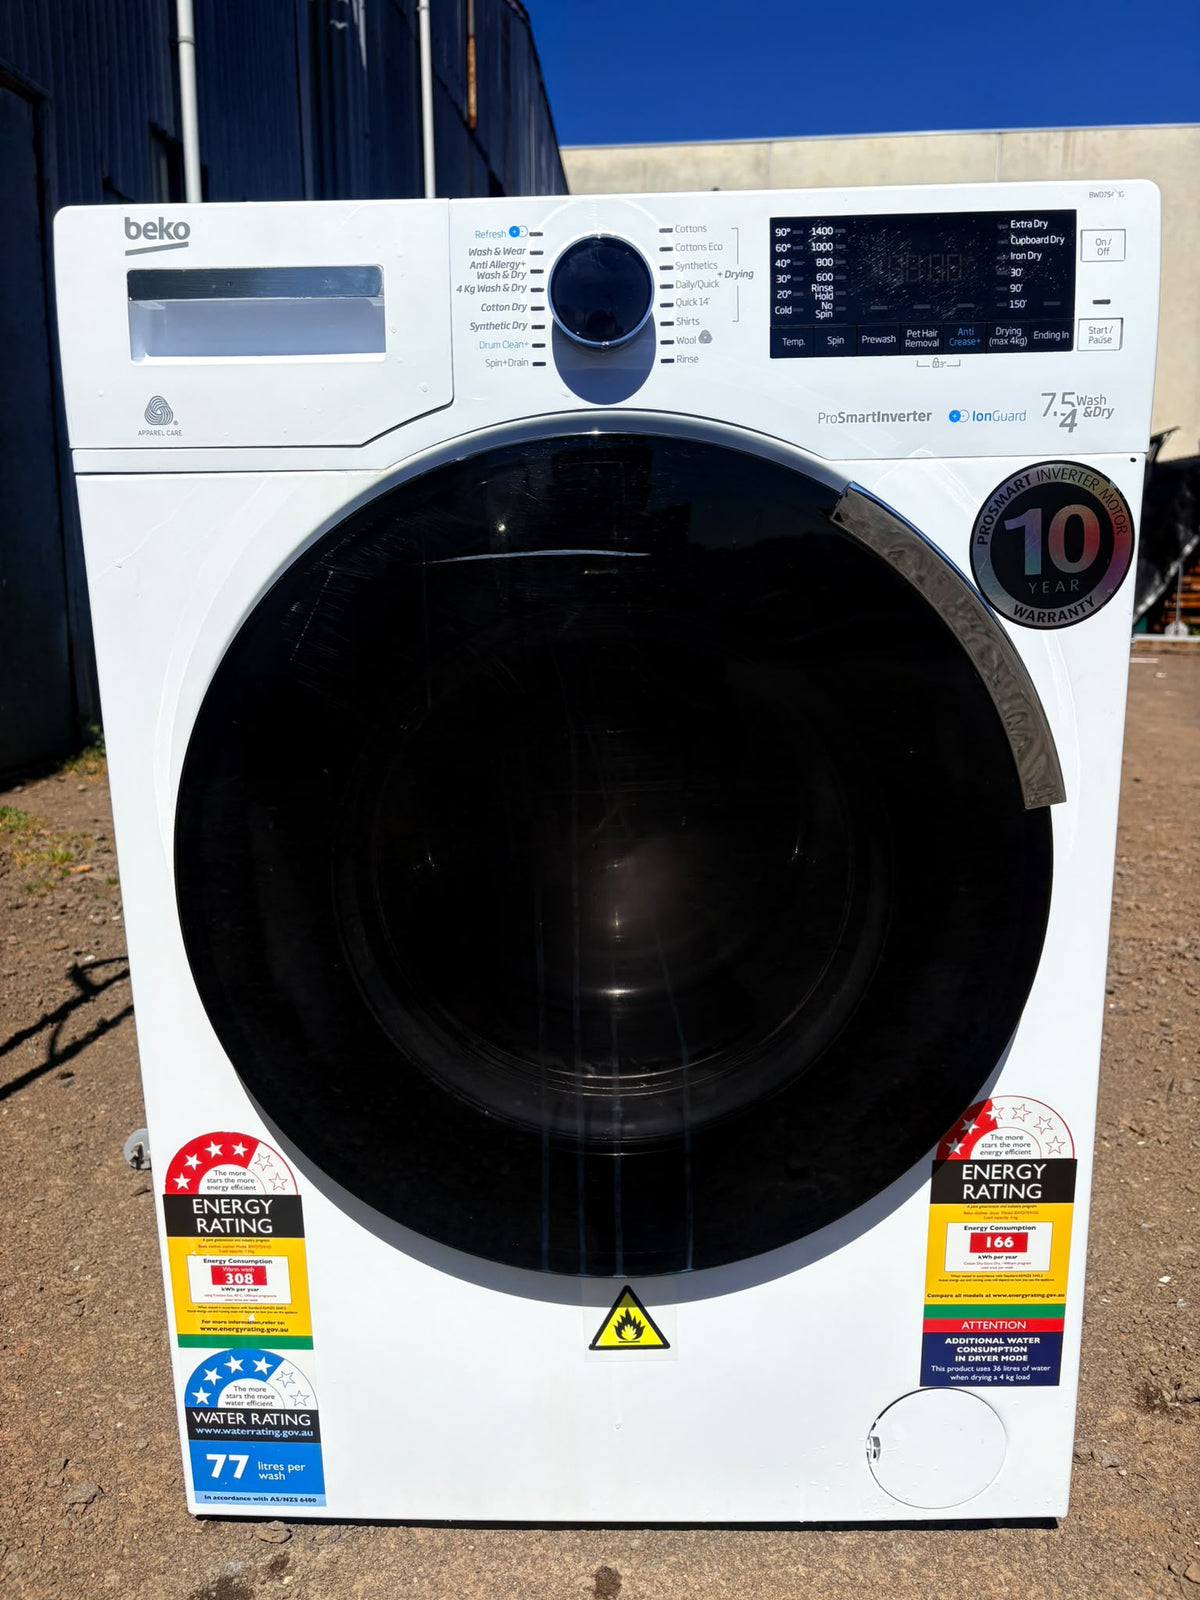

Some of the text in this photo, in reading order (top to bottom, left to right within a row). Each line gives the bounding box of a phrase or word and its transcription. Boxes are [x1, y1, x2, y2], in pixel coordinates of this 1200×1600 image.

[125, 217, 190, 240] beko
[675, 224, 707, 233] Cottons
[1011, 219, 1048, 229] Extra Dry
[475, 230, 507, 239] Refresh
[775, 228, 791, 237] 90°
[811, 227, 833, 235] 1400
[1011, 235, 1065, 246] Cupboard Dry
[468, 247, 526, 256] Wash & Wear
[675, 242, 723, 251] Cottons Eco
[775, 243, 791, 252] 60°
[811, 242, 833, 251] 1000
[1097, 247, 1110, 256] Off
[1011, 251, 1042, 261] Iron Dry
[470, 260, 526, 271] Anti Allergy+
[675, 260, 718, 271] Synthetics
[775, 259, 791, 267] 40°
[816, 258, 833, 267] 800
[476, 270, 527, 280] Wash & Dry
[725, 269, 754, 280] Drying
[776, 274, 791, 283] 30°
[816, 273, 833, 281] 600
[456, 283, 527, 294] 4 Kg Wash & Dry
[676, 279, 720, 290] Daily/Quick
[811, 284, 834, 292] Rinse
[777, 290, 791, 298] 20°
[815, 291, 833, 300] Hold
[676, 298, 697, 307] Quick
[821, 302, 833, 310] No
[480, 303, 527, 313] Cotton Dry
[775, 306, 792, 314] Cold
[815, 310, 833, 319] Spin
[470, 321, 528, 332] Synthetic Dry
[676, 317, 700, 326] Shirts
[907, 328, 938, 338] Pet Hair
[958, 328, 974, 336] Anti
[996, 326, 1021, 337] Drying
[1034, 330, 1069, 342] Ending In
[676, 336, 696, 344] Wool
[782, 337, 806, 348] Temp.
[827, 336, 844, 346] Spin
[862, 334, 896, 344] Prewash
[905, 338, 939, 347] Removal
[949, 337, 981, 346] Crease+
[989, 336, 1027, 347] (max 4kg)
[1088, 335, 1112, 345] Pause
[479, 340, 528, 349] Drum Clean+
[485, 358, 528, 368] Spin+Drain
[676, 354, 699, 363] Rinse
[1077, 394, 1107, 406] Wash
[818, 410, 932, 425] ProSmartInverter
[972, 410, 1026, 423] IonGuard
[1083, 406, 1114, 419] &Dry
[1059, 409, 1078, 433] 4
[977, 467, 1129, 545] PROSMART INVERTER MOTOR
[1004, 503, 1101, 576] 10
[1028, 579, 1080, 594] YEAR
[1013, 596, 1096, 623] WARRANTY
[962, 1164, 1047, 1180] ENERGY
[963, 1184, 1042, 1199] RATING
[193, 1199, 273, 1215] ENERGY
[197, 1218, 273, 1234] RATING
[986, 1237, 1014, 1248] 166
[225, 1273, 254, 1284] 308
[200, 1325, 289, 1333] www.energyrating.gov.au
[961, 1321, 1026, 1330] ATTENTION
[192, 1412, 311, 1426] WATER RATING
[195, 1427, 313, 1438] www.waterrating.gov.au
[206, 1454, 249, 1479] 77
[258, 1461, 306, 1473] litres per
[259, 1470, 286, 1480] wash
